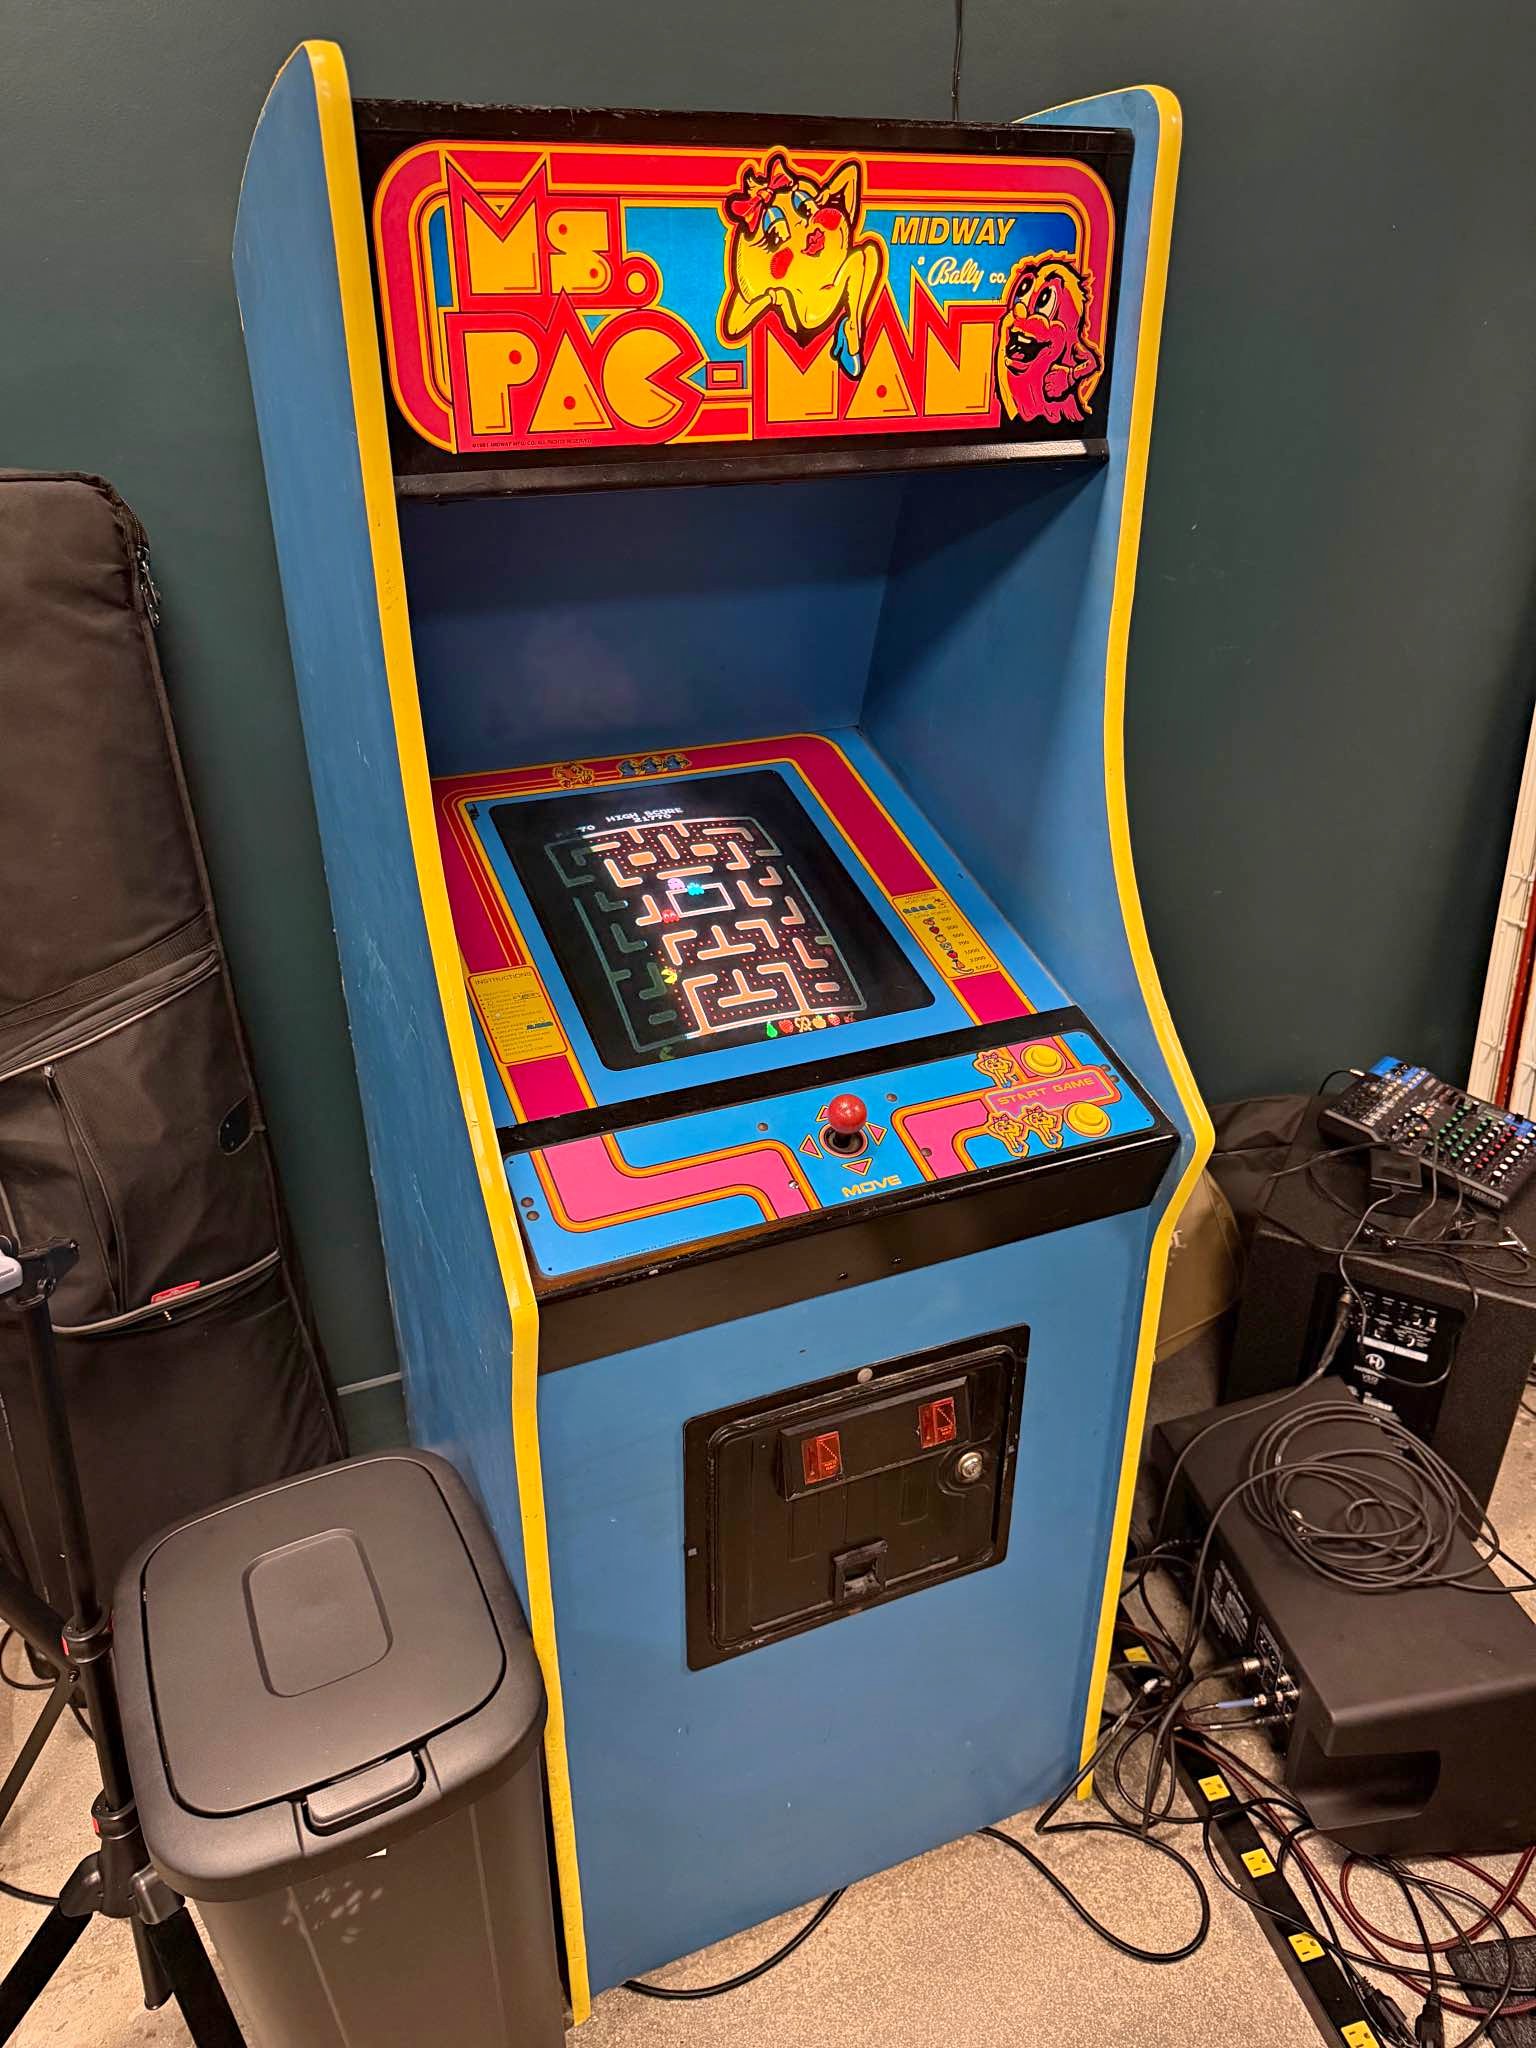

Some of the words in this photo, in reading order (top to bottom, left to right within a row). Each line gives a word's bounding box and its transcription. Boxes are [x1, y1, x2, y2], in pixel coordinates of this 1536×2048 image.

[891, 216, 1016, 245] MIDWAY
[927, 256, 985, 293] Bally
[453, 302, 998, 441] PAC-MAN
[605, 812, 639, 822] HIGH
[644, 807, 683, 818] SCORE
[998, 1087, 1047, 1105] START
[1052, 1077, 1095, 1093] GAME
[842, 1175, 902, 1197] MOVE
